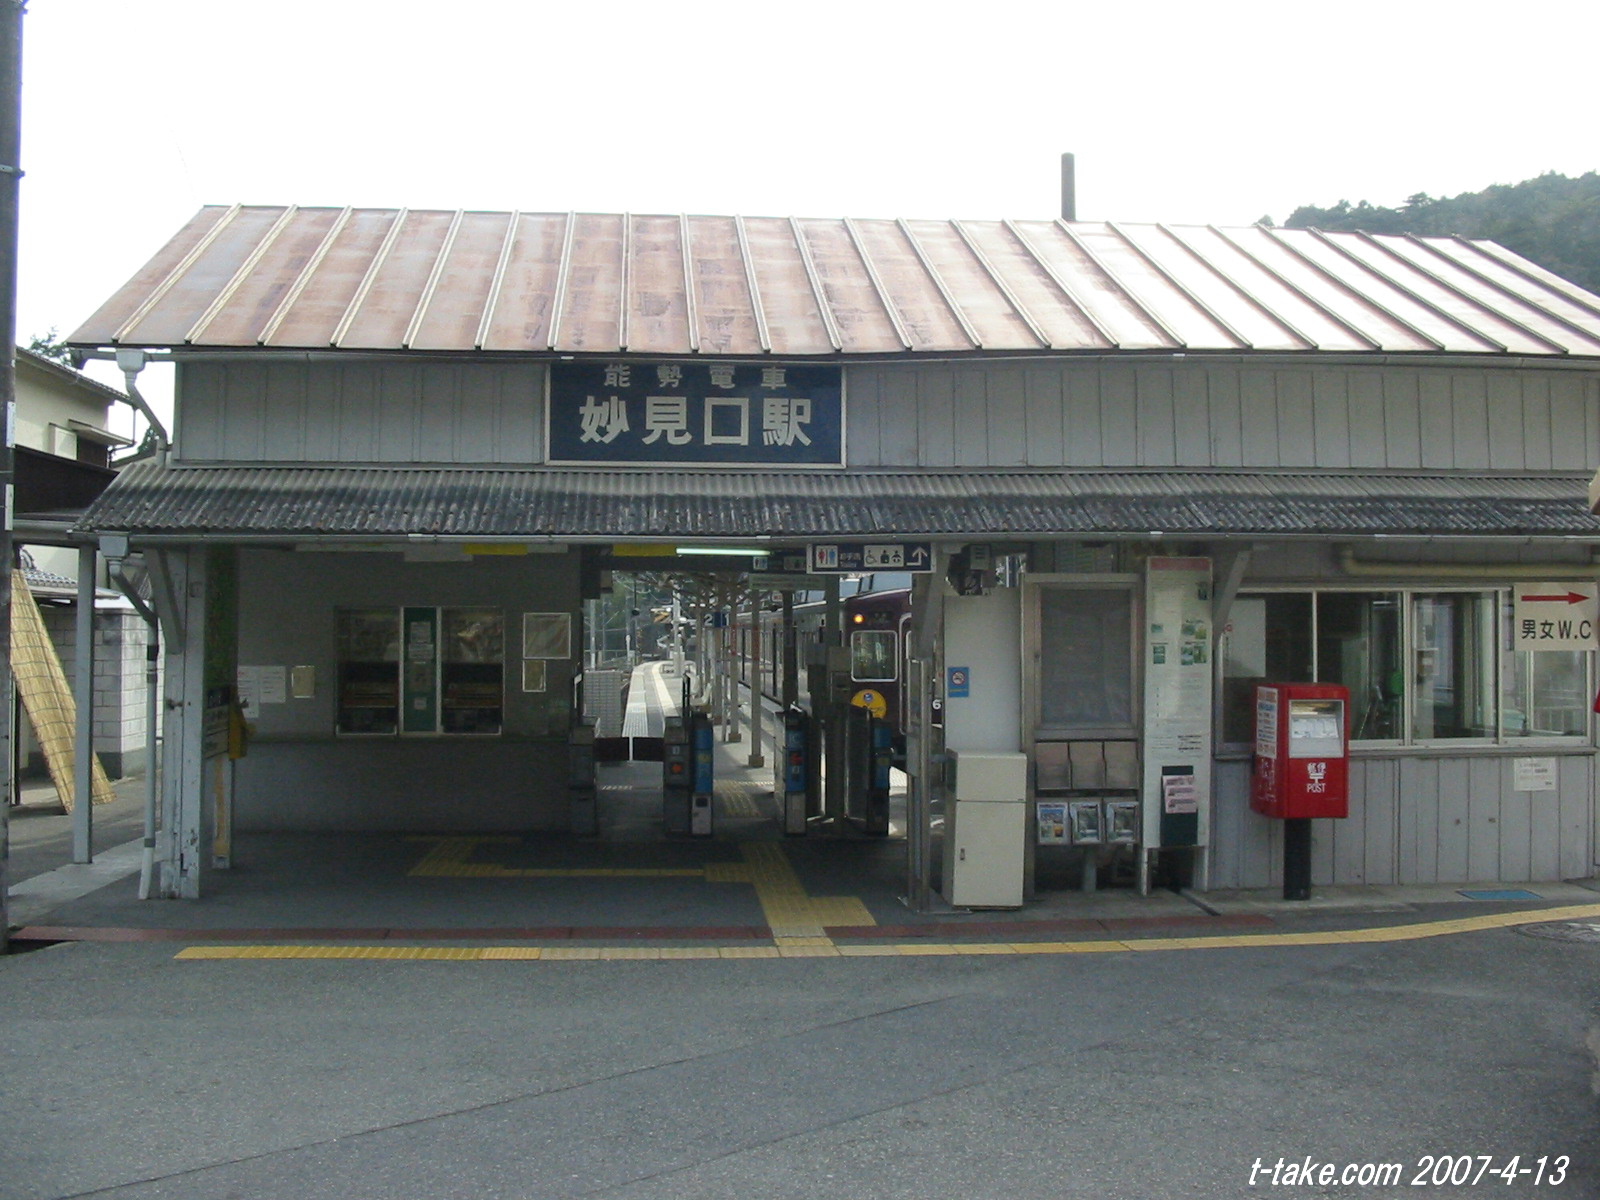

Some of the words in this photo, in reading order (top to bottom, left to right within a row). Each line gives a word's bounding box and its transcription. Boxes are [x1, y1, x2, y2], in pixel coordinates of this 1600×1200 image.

[603, 364, 787, 390] 能勢電車
[579, 395, 812, 446] 妙見口駅
[703, 613, 713, 626] 2
[1307, 783, 1326, 793] POST
